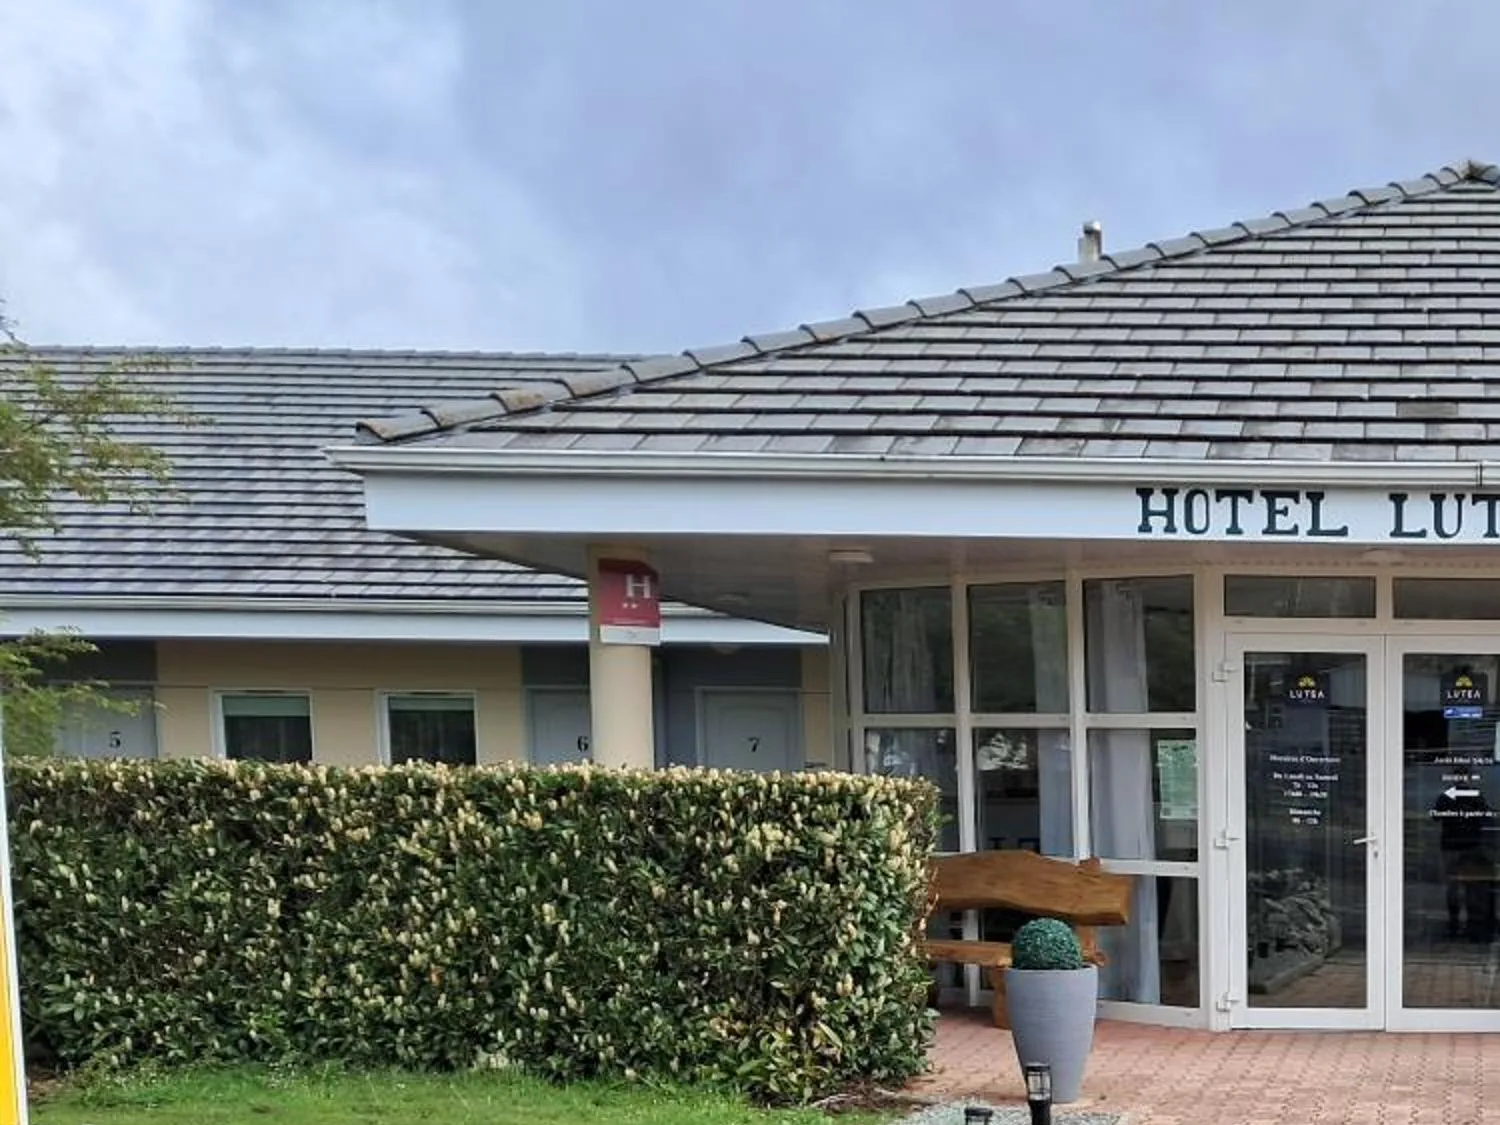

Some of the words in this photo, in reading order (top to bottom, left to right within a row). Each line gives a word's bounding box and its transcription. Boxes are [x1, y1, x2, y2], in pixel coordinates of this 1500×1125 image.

[1135, 487, 1349, 535] HOTEL
[625, 573, 652, 599] H
[109, 730, 121, 749] 5
[577, 735, 589, 752] 6
[748, 736, 760, 752] 7
